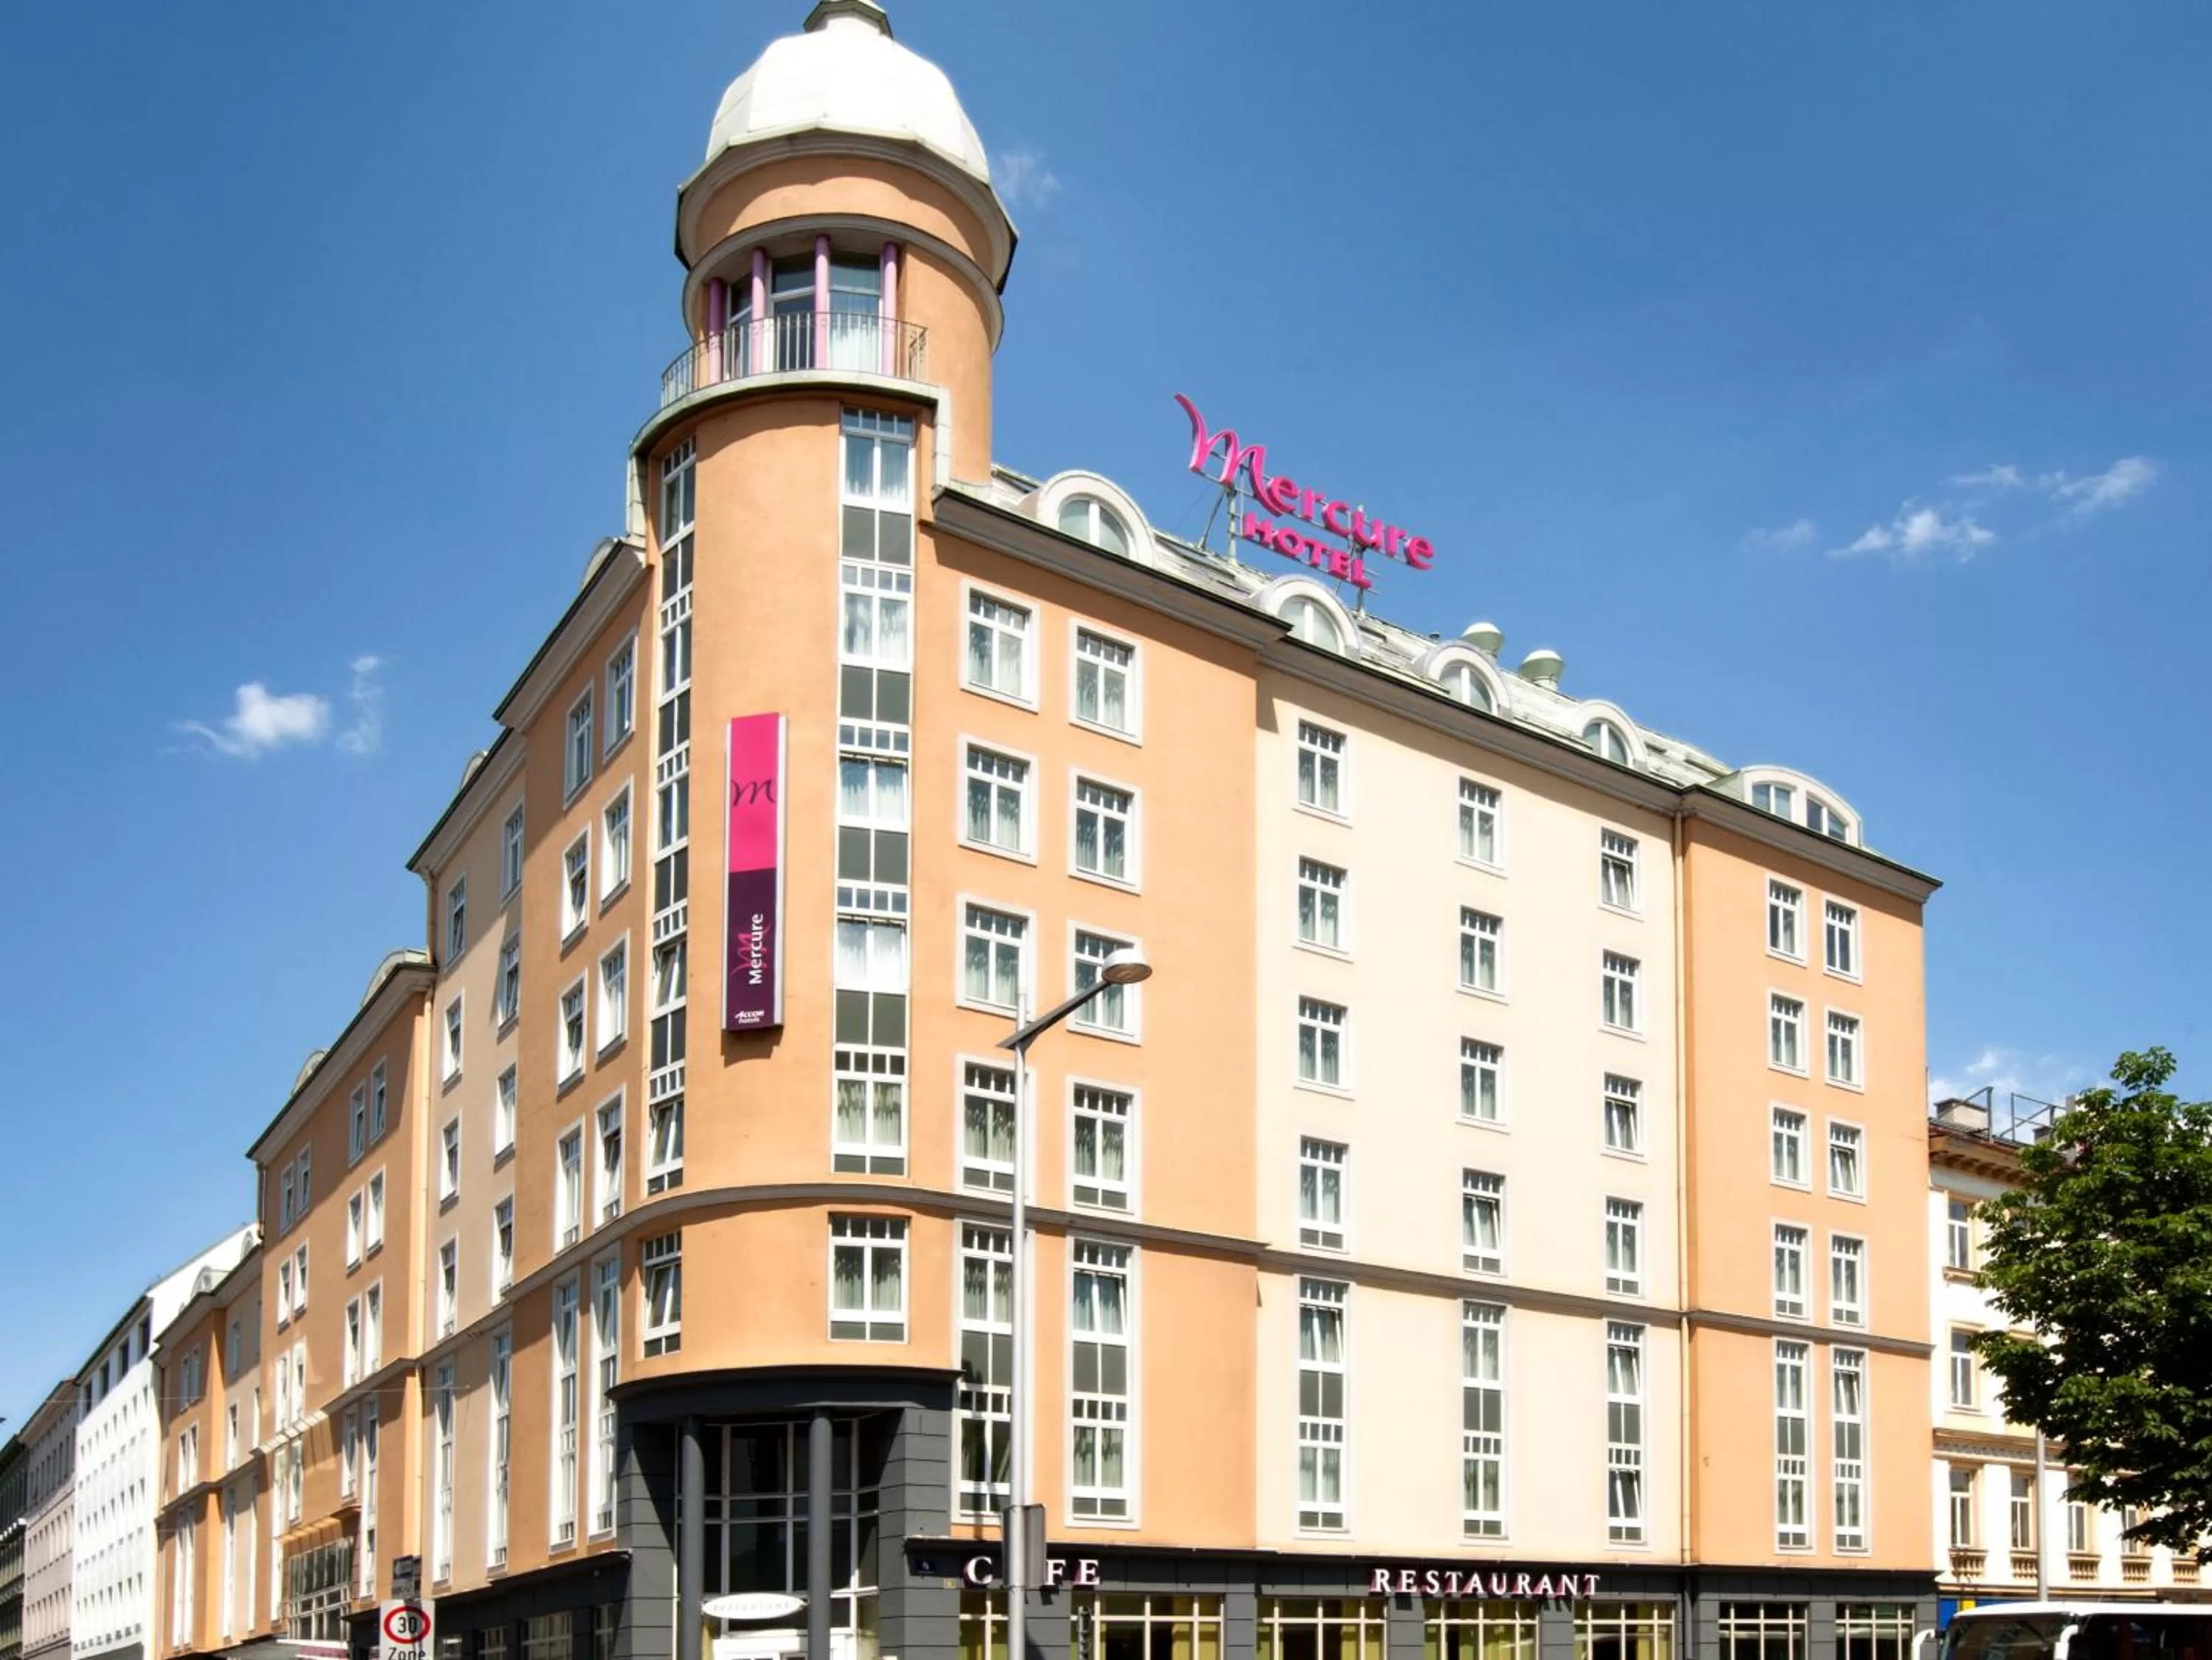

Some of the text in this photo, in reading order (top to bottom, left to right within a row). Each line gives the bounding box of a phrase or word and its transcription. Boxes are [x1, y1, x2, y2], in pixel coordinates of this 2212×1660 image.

[1242, 512, 1372, 589] HOTEL
[748, 913, 763, 985] Mercure
[964, 1556, 1101, 1586] CFE
[1371, 1568, 1601, 1597] RESTAURANT
[397, 1617, 418, 1633] 30
[389, 1647, 426, 1660] Zone
